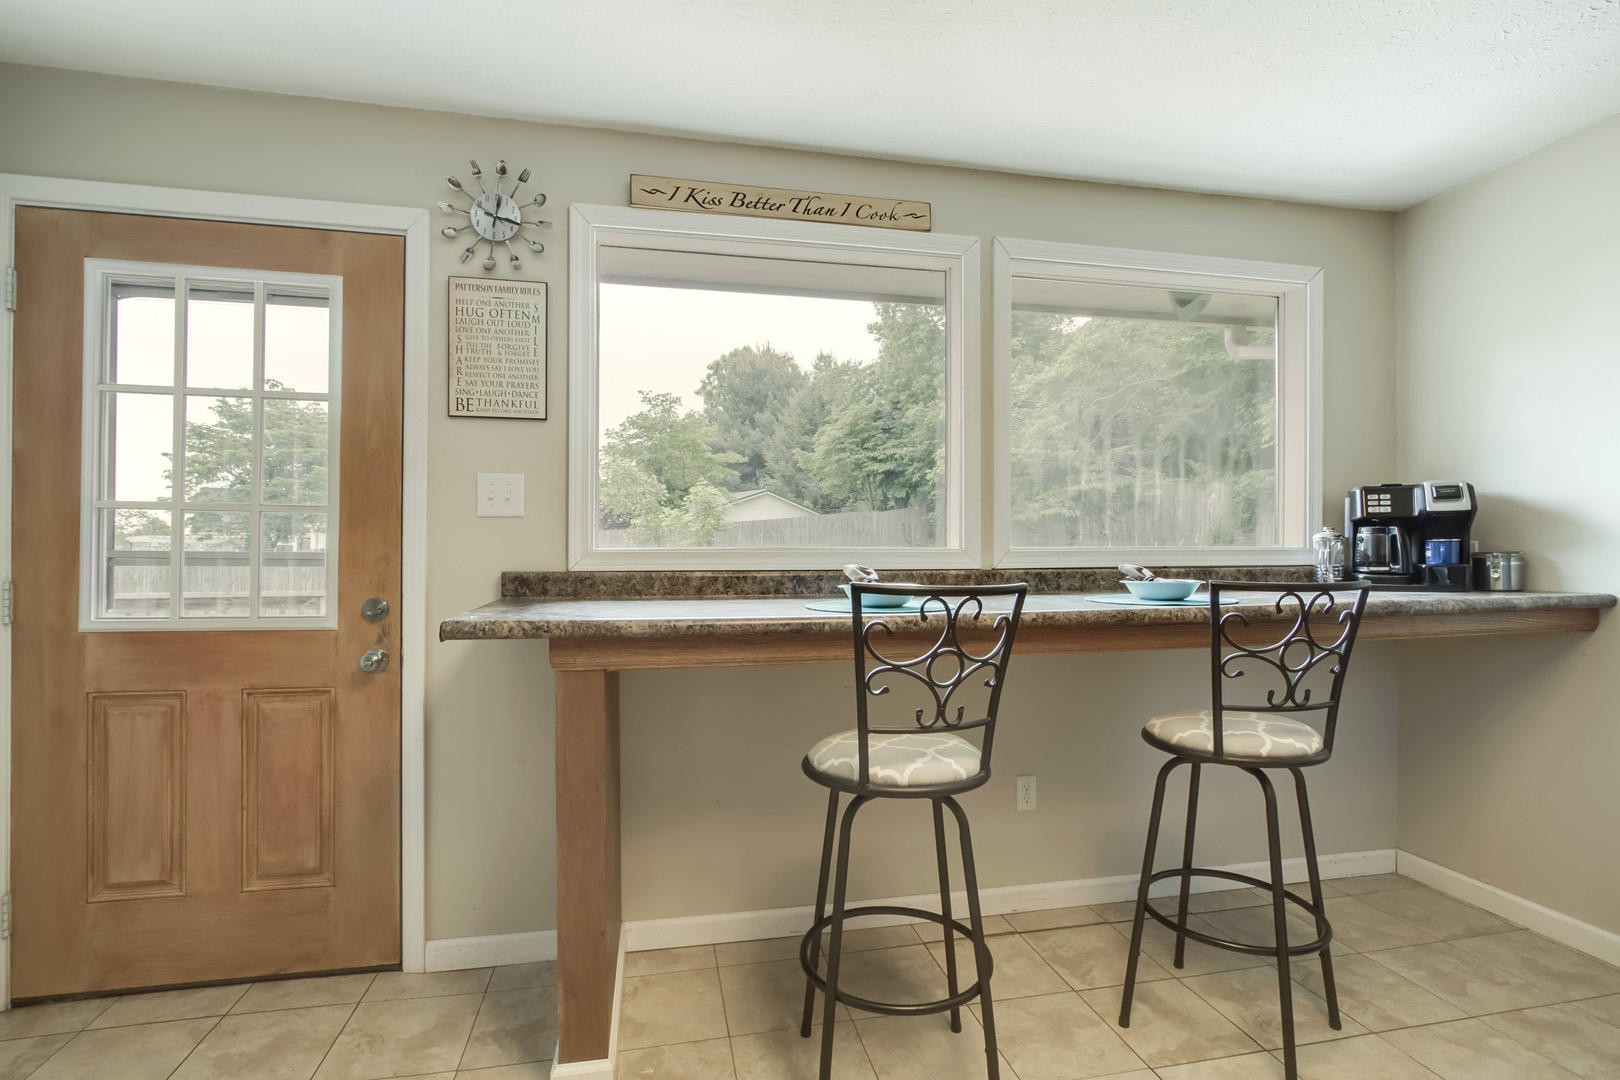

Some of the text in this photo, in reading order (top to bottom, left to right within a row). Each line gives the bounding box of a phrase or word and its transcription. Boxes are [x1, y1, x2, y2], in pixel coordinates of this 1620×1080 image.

[684, 187, 722, 210] Kiss
[729, 191, 786, 212] Better
[789, 196, 837, 216] Than
[856, 202, 902, 221] Cook
[456, 283, 493, 292] PATTERSON
[494, 285, 519, 294] FAMILY
[456, 306, 530, 320] HUG OFTEN
[507, 381, 539, 390] PRAYERS
[456, 397, 538, 412] BE THANKFUL
